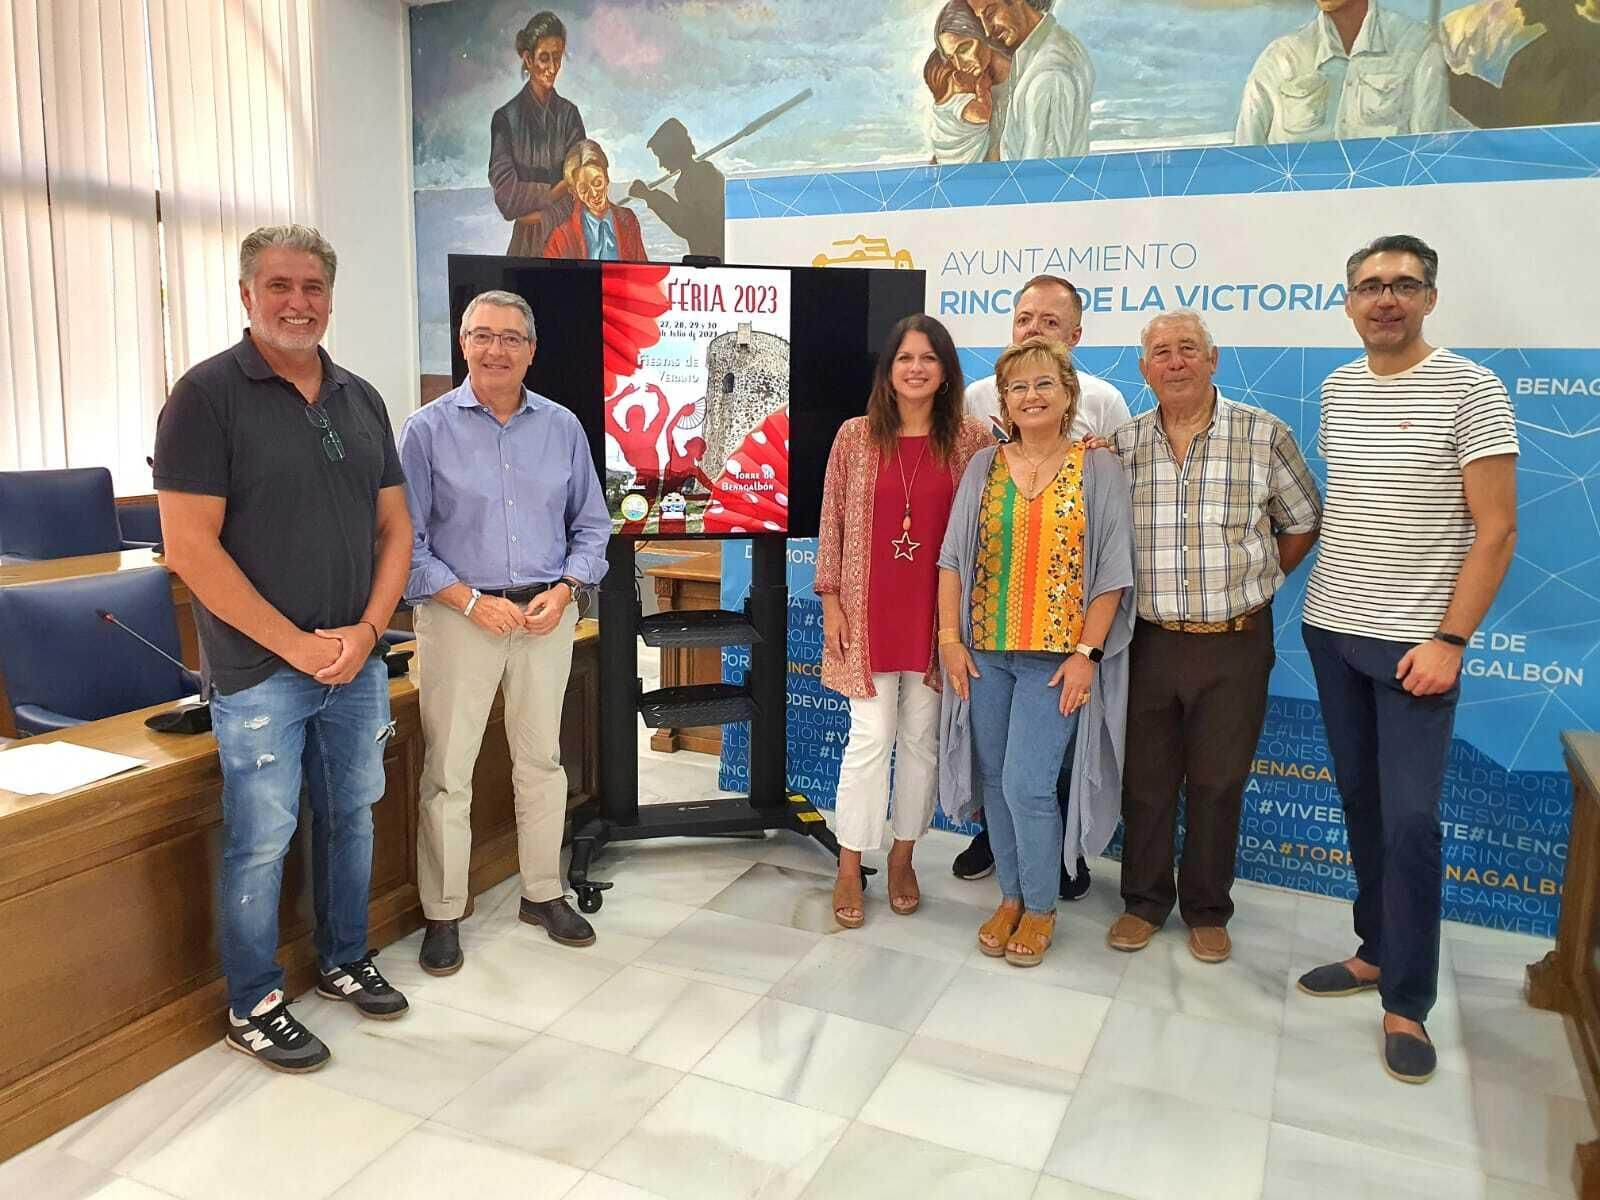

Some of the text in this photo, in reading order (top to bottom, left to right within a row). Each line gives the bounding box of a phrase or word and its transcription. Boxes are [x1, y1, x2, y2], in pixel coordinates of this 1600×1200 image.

[941, 243, 1197, 276] AYUNTAMIENTO
[734, 284, 777, 314] 2023
[940, 287, 1022, 316] RINC
[1121, 286, 1166, 313] LA
[1174, 284, 1347, 312] VICTORIA
[1515, 377, 1600, 396] BENAG
[1490, 632, 1527, 653] DE
[1461, 657, 1584, 687] GALBÓN
